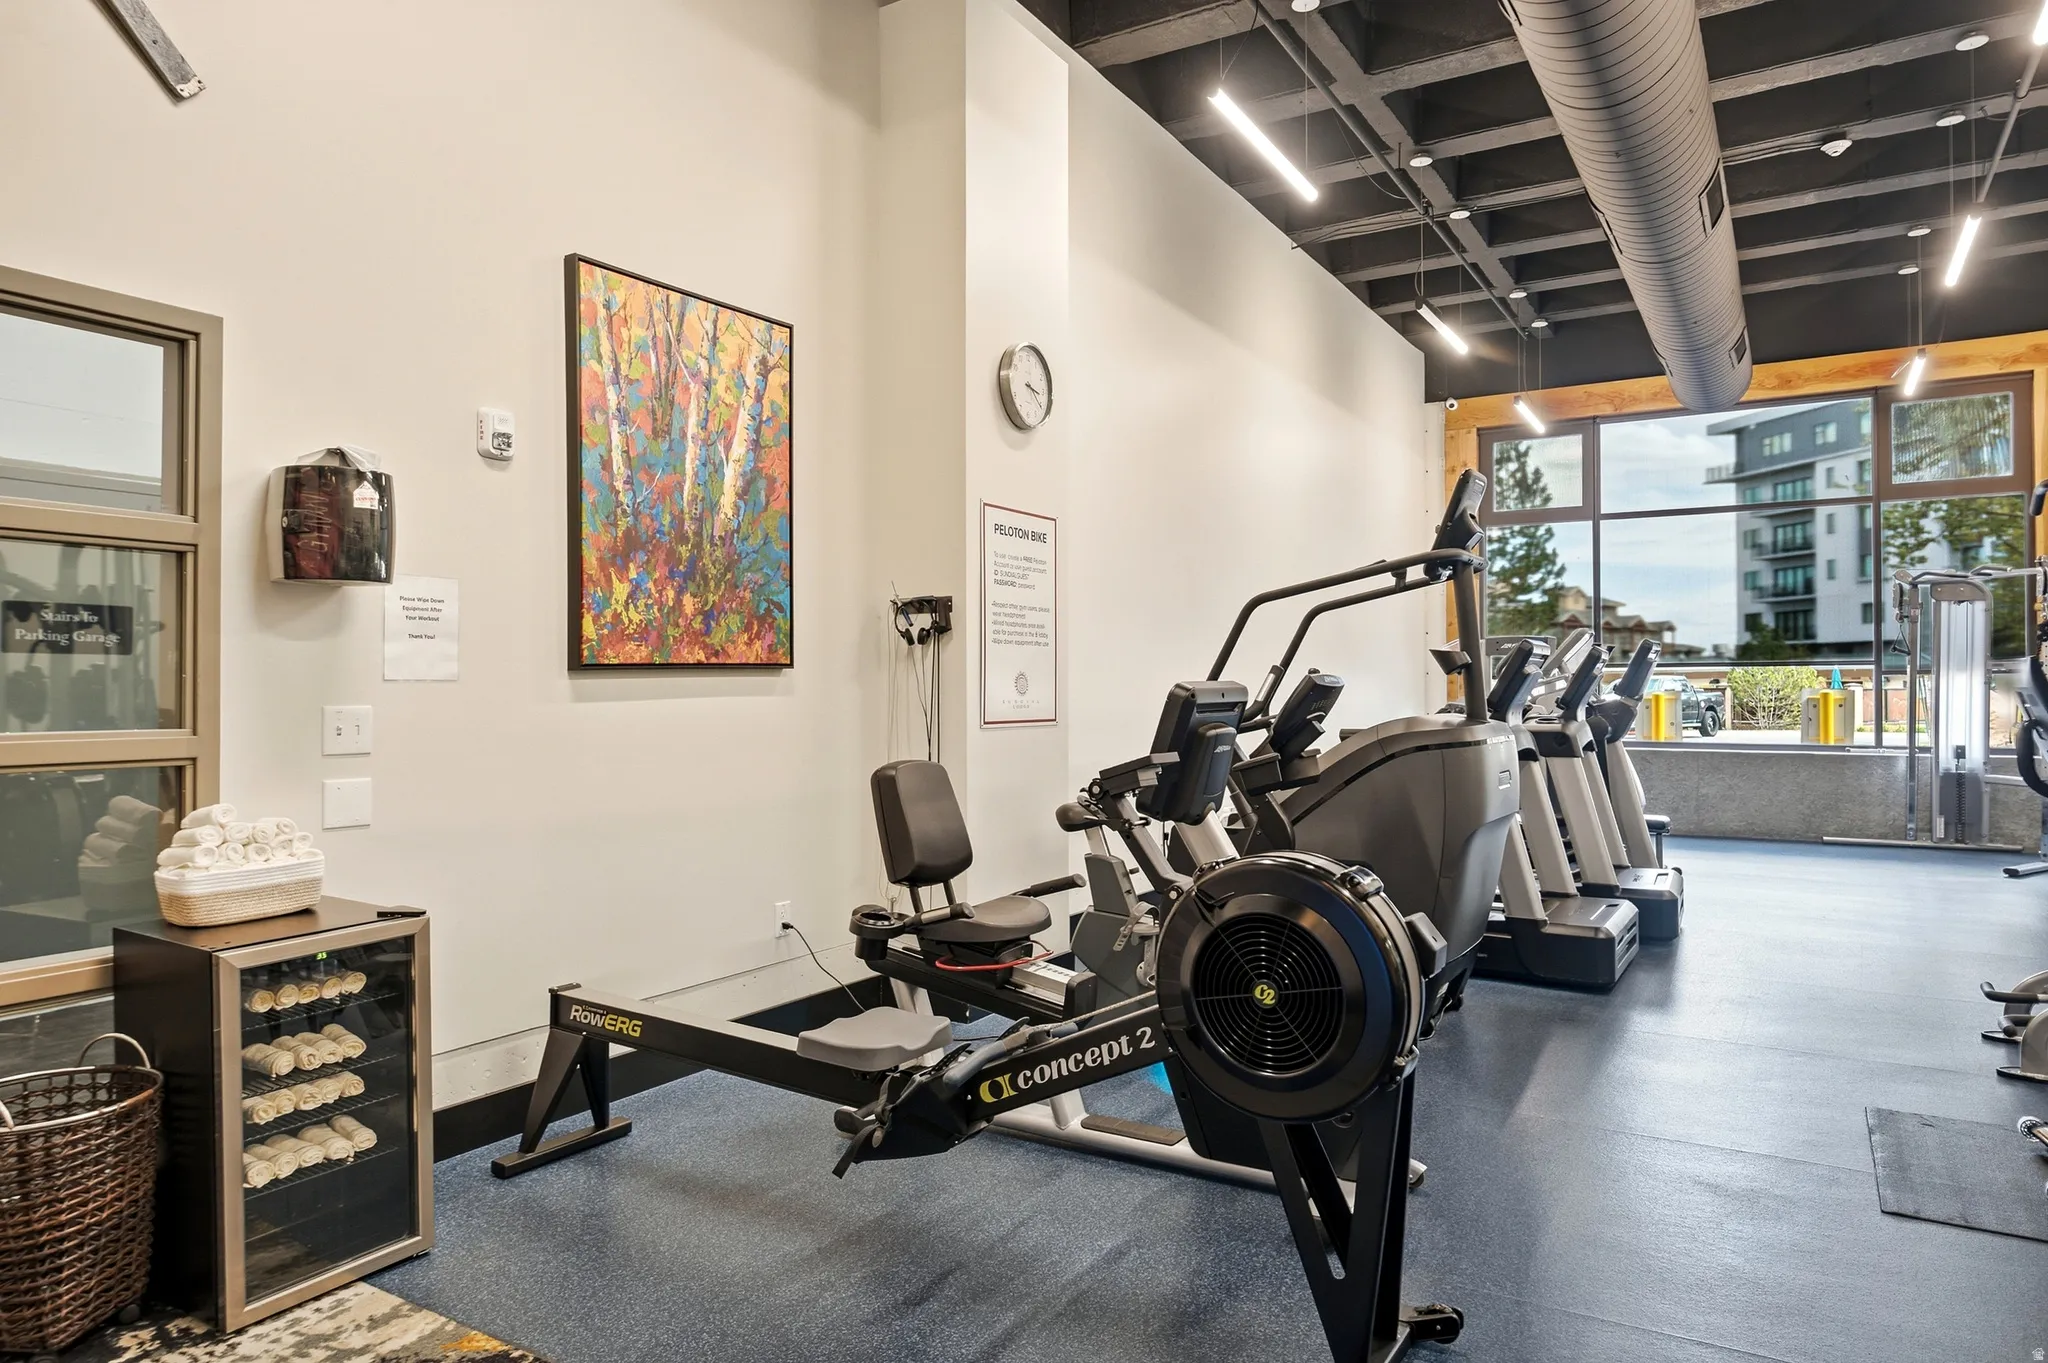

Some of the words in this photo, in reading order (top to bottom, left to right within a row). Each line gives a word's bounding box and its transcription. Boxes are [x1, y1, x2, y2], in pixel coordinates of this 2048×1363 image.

[994, 523, 1030, 540] PELOTON
[1031, 530, 1047, 544] BIKE
[416, 596, 429, 604] Wipe
[40, 609, 79, 622] Stairs
[79, 610, 99, 623] To
[14, 628, 70, 646] Parking
[72, 630, 121, 647] Garage
[1017, 1034, 1133, 1090] concept
[1136, 1026, 1156, 1049] 2
